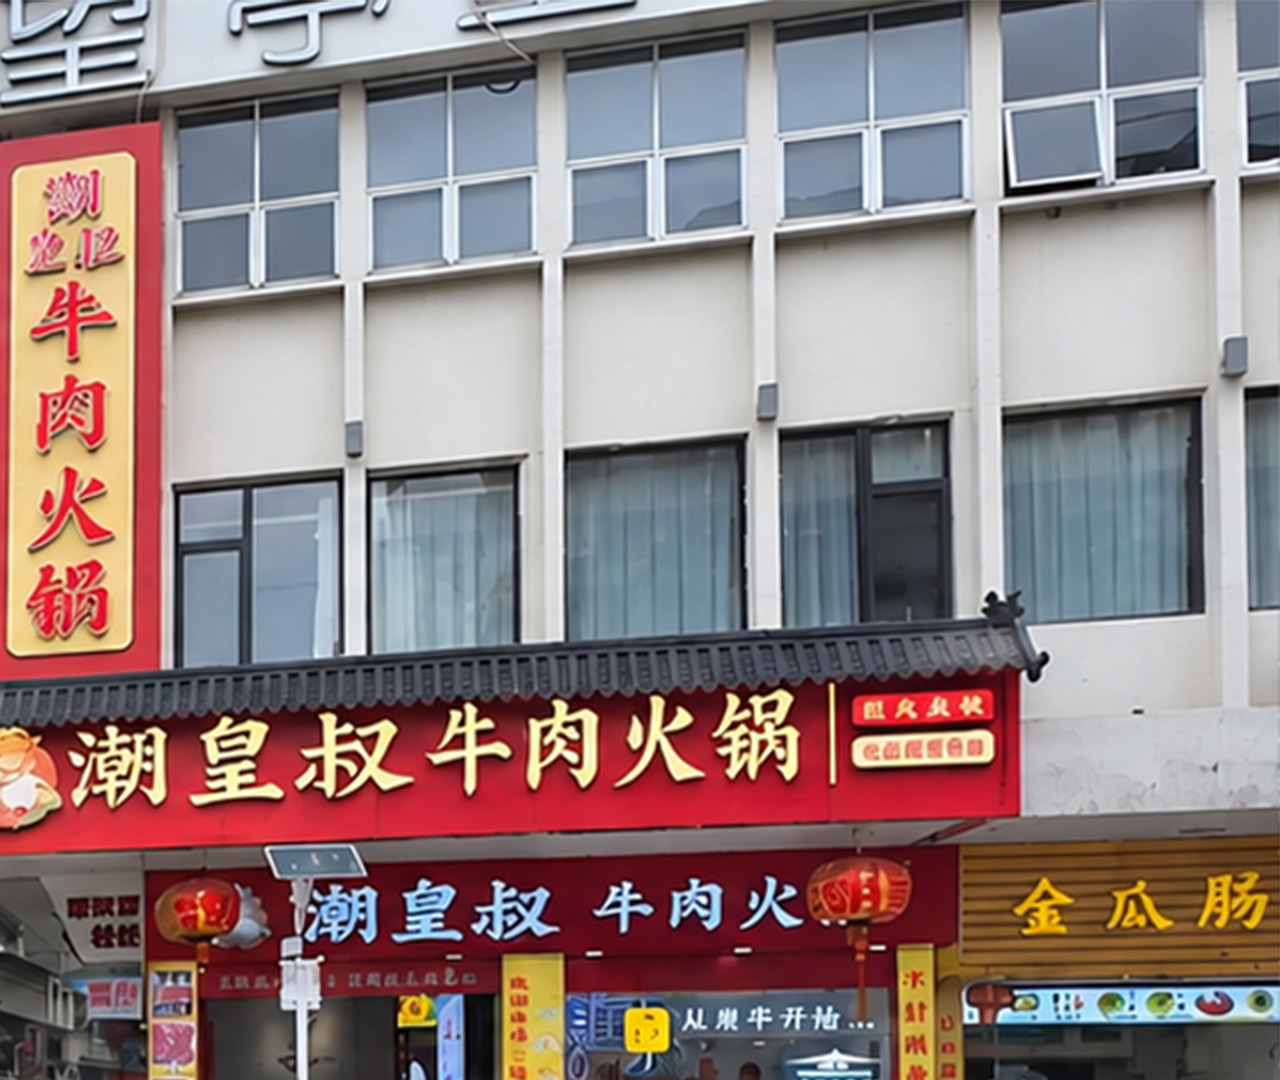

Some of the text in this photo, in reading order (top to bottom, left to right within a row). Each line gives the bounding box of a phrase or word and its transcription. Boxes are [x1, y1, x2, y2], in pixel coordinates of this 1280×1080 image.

[68, 688, 802, 809] 潮皇叔牛肉火锅
[302, 874, 848, 944] 潮皇叔牛肉火
